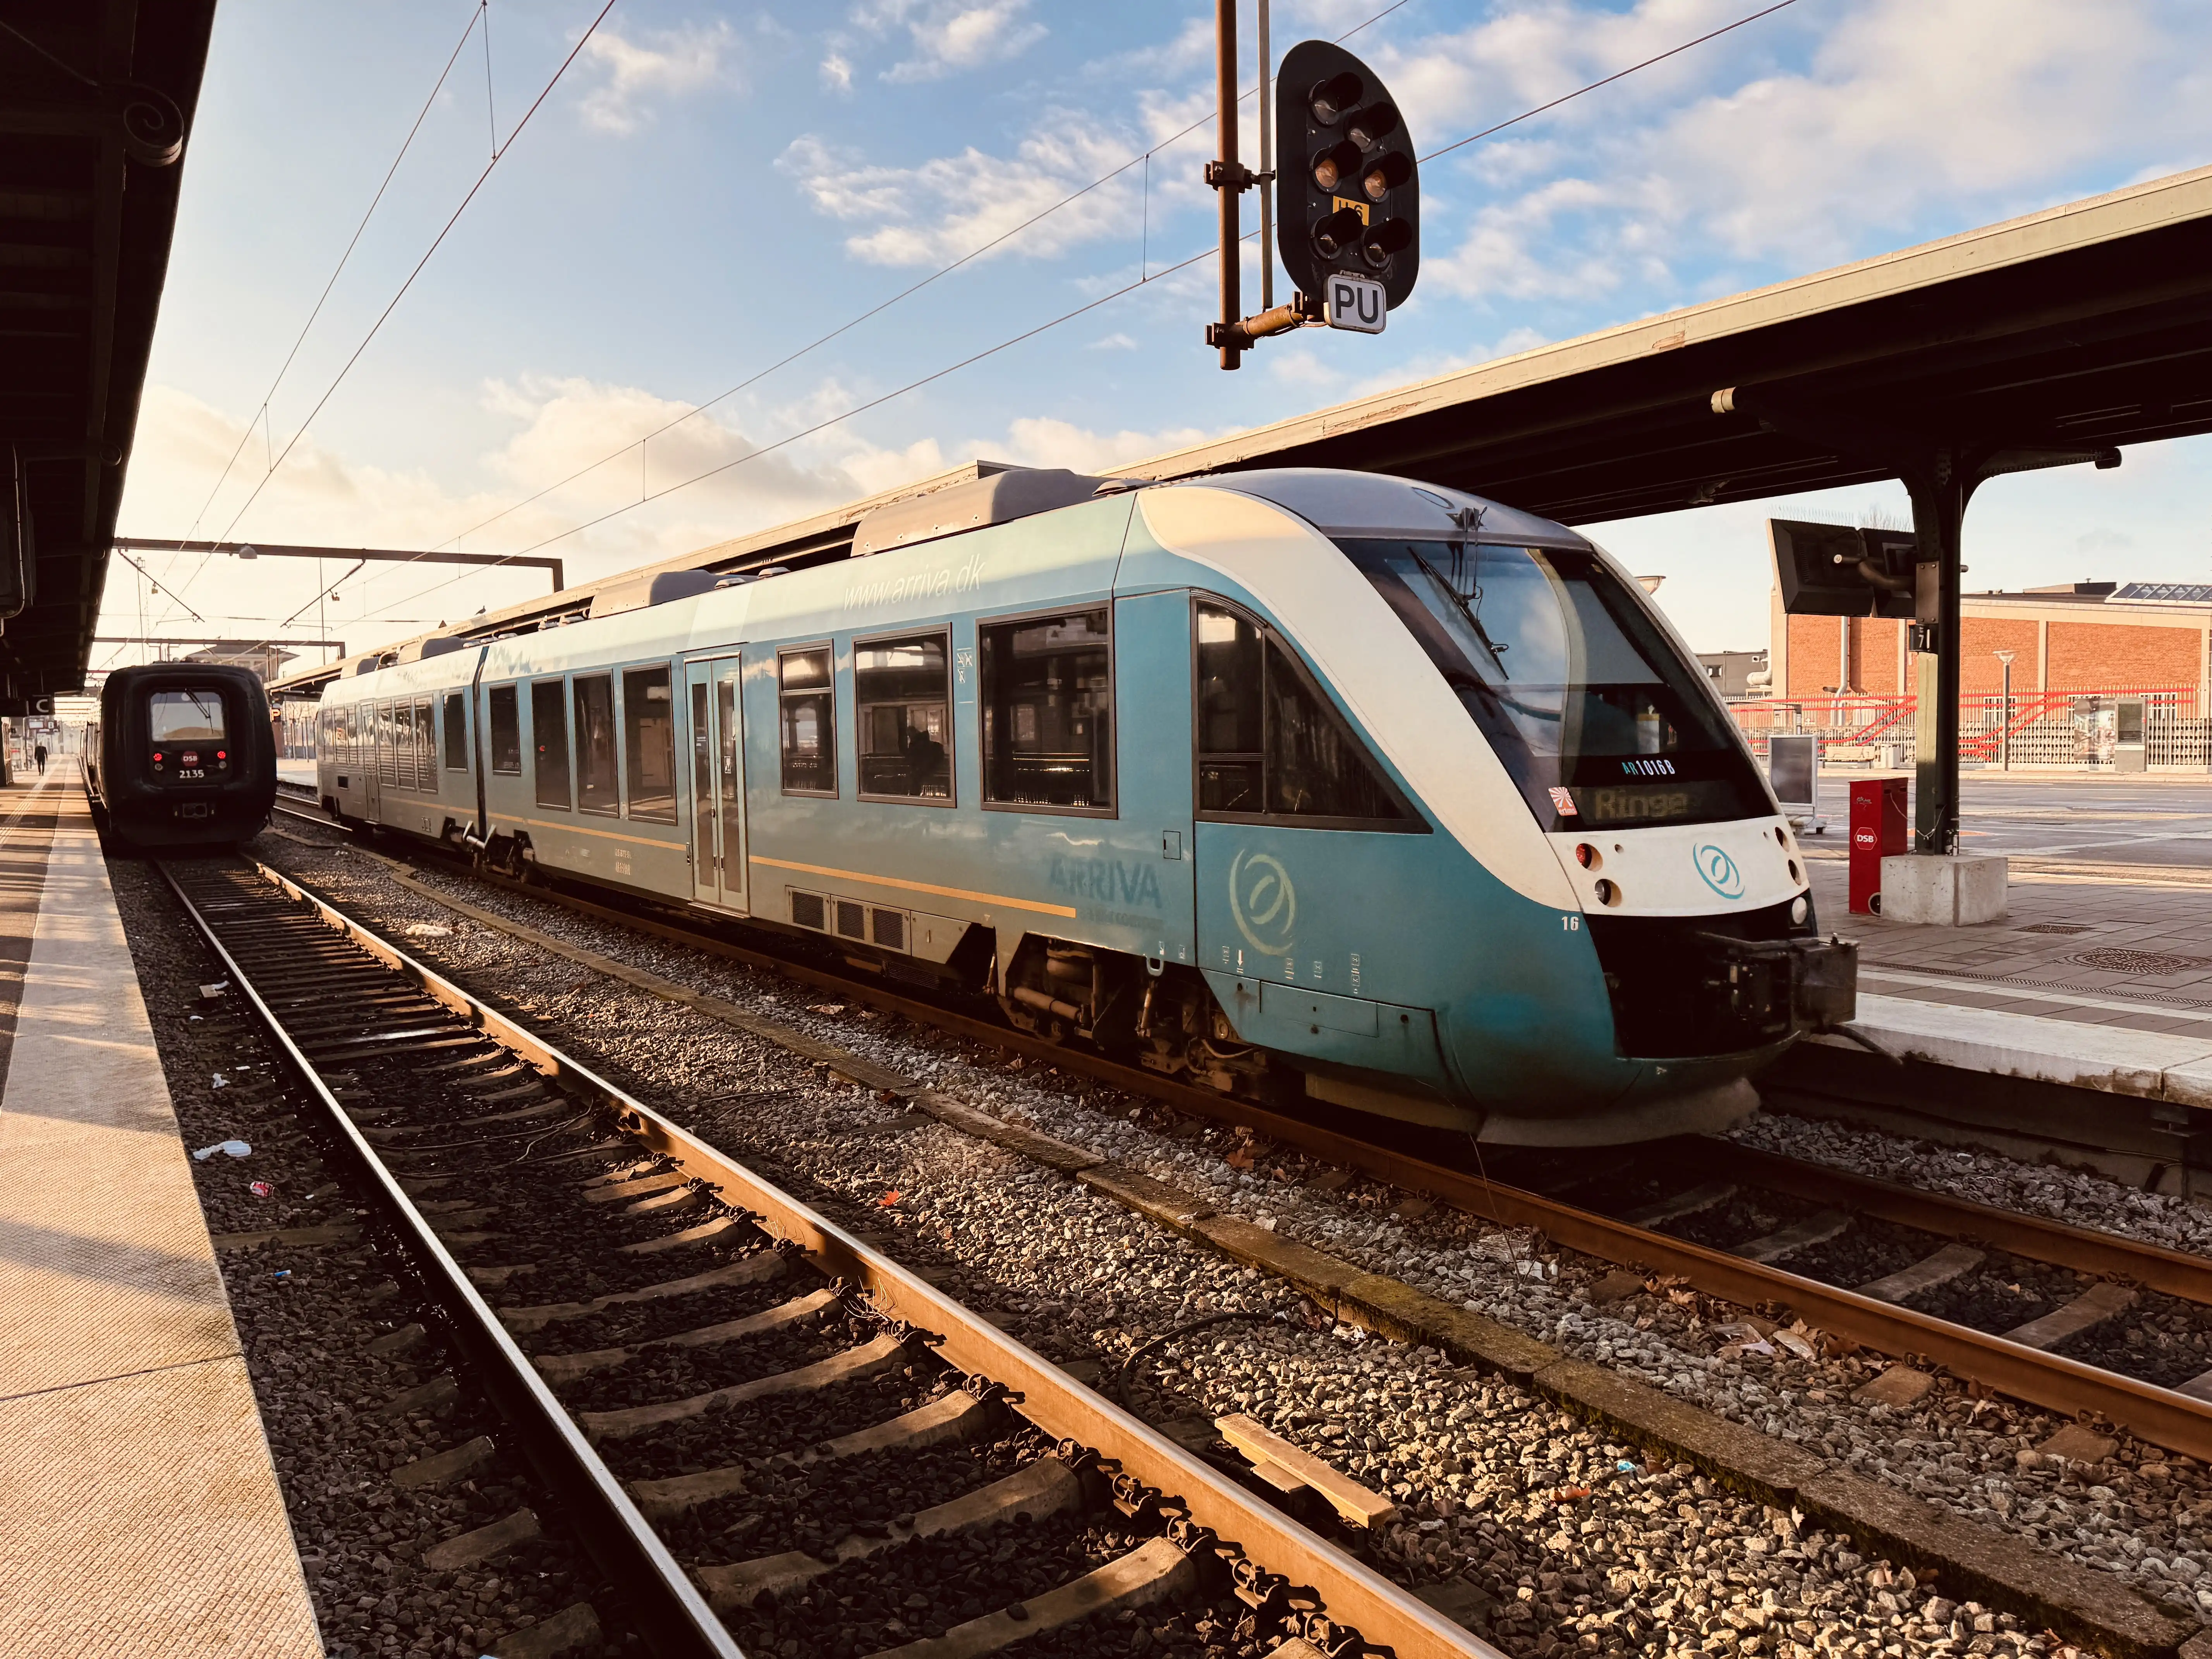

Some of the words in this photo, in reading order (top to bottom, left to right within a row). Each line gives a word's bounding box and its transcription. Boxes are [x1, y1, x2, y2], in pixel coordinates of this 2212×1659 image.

[1335, 283, 1378, 324] PU
[844, 553, 986, 611] www.arriva.dk
[36, 699, 49, 713] C
[271, 709, 281, 721] P
[179, 769, 204, 778] 2135
[1856, 835, 1874, 843] DSB
[1561, 916, 1579, 931] 16
